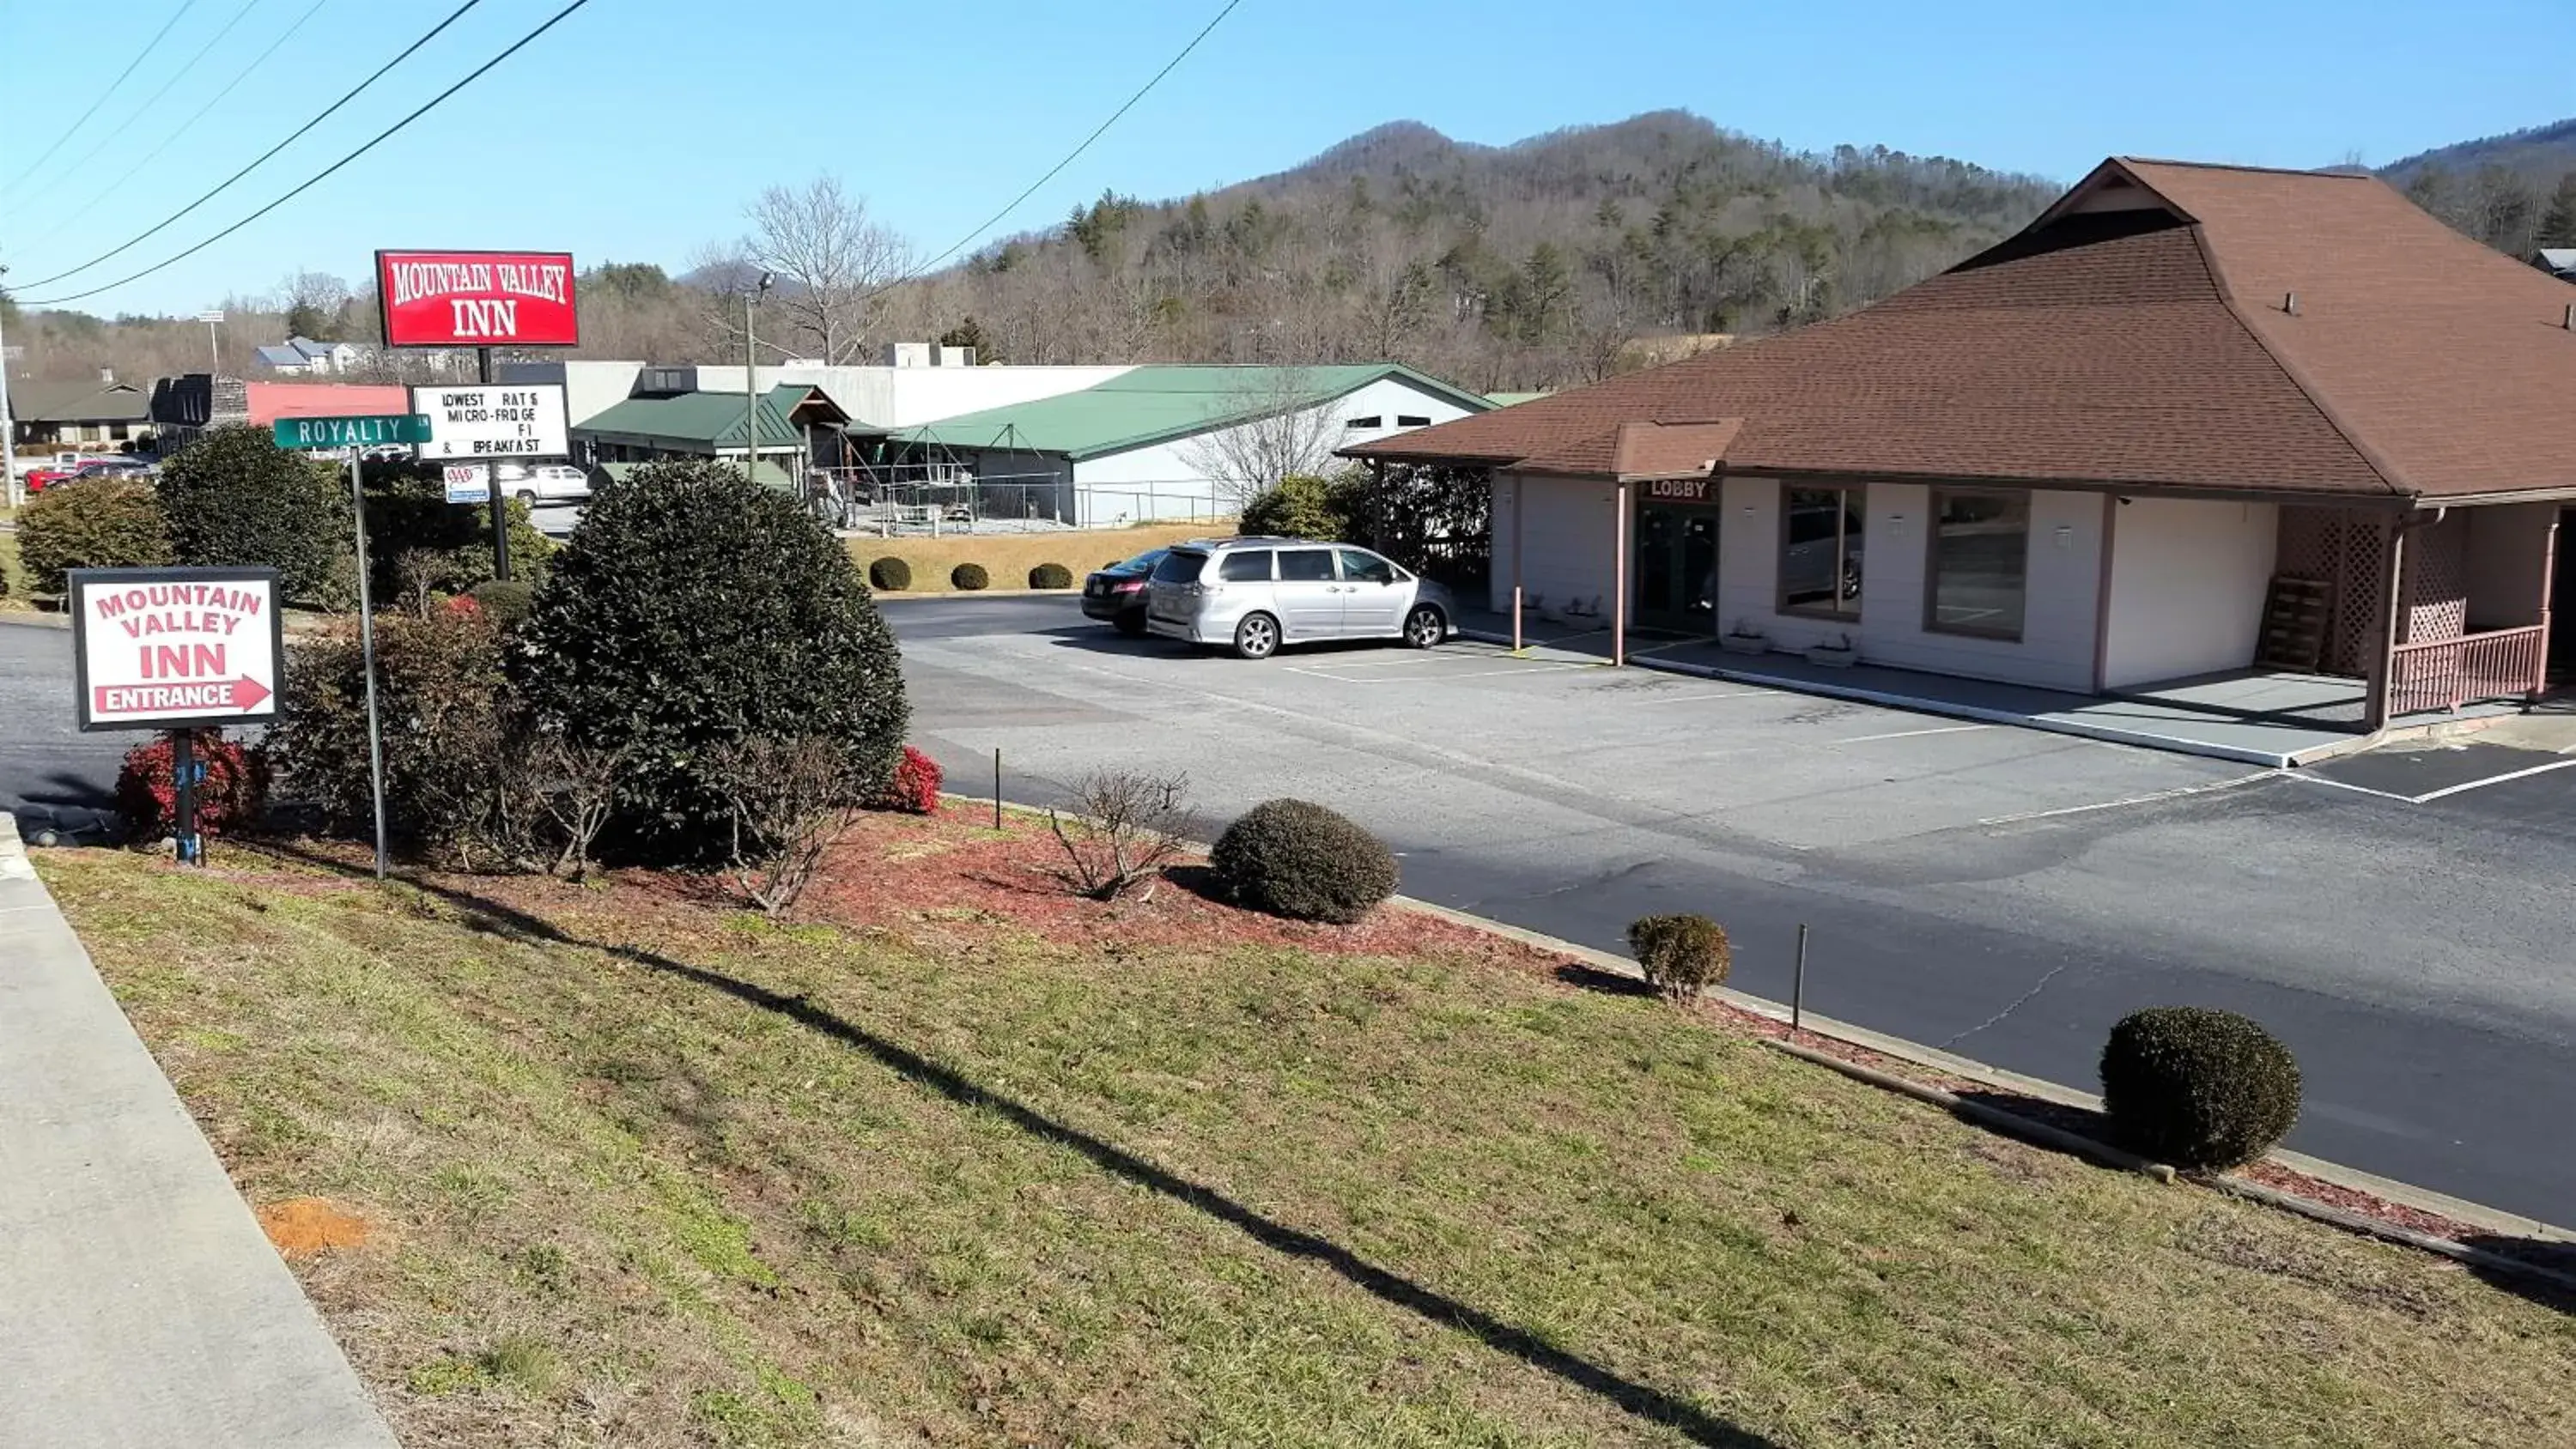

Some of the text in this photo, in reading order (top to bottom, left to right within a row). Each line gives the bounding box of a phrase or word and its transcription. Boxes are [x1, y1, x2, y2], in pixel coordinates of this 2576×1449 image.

[391, 262, 567, 306] MOUNTAIN VALLEY
[450, 300, 517, 337] INN
[442, 393, 484, 407] LOWEST
[300, 419, 399, 443] ROYALTY
[443, 441, 452, 453] &
[1651, 480, 1706, 498] LOBBY
[96, 585, 261, 619] MOUNTAIN
[121, 611, 240, 639] VALLEY
[139, 644, 227, 679] INN
[106, 685, 234, 710] ENTRANCE
